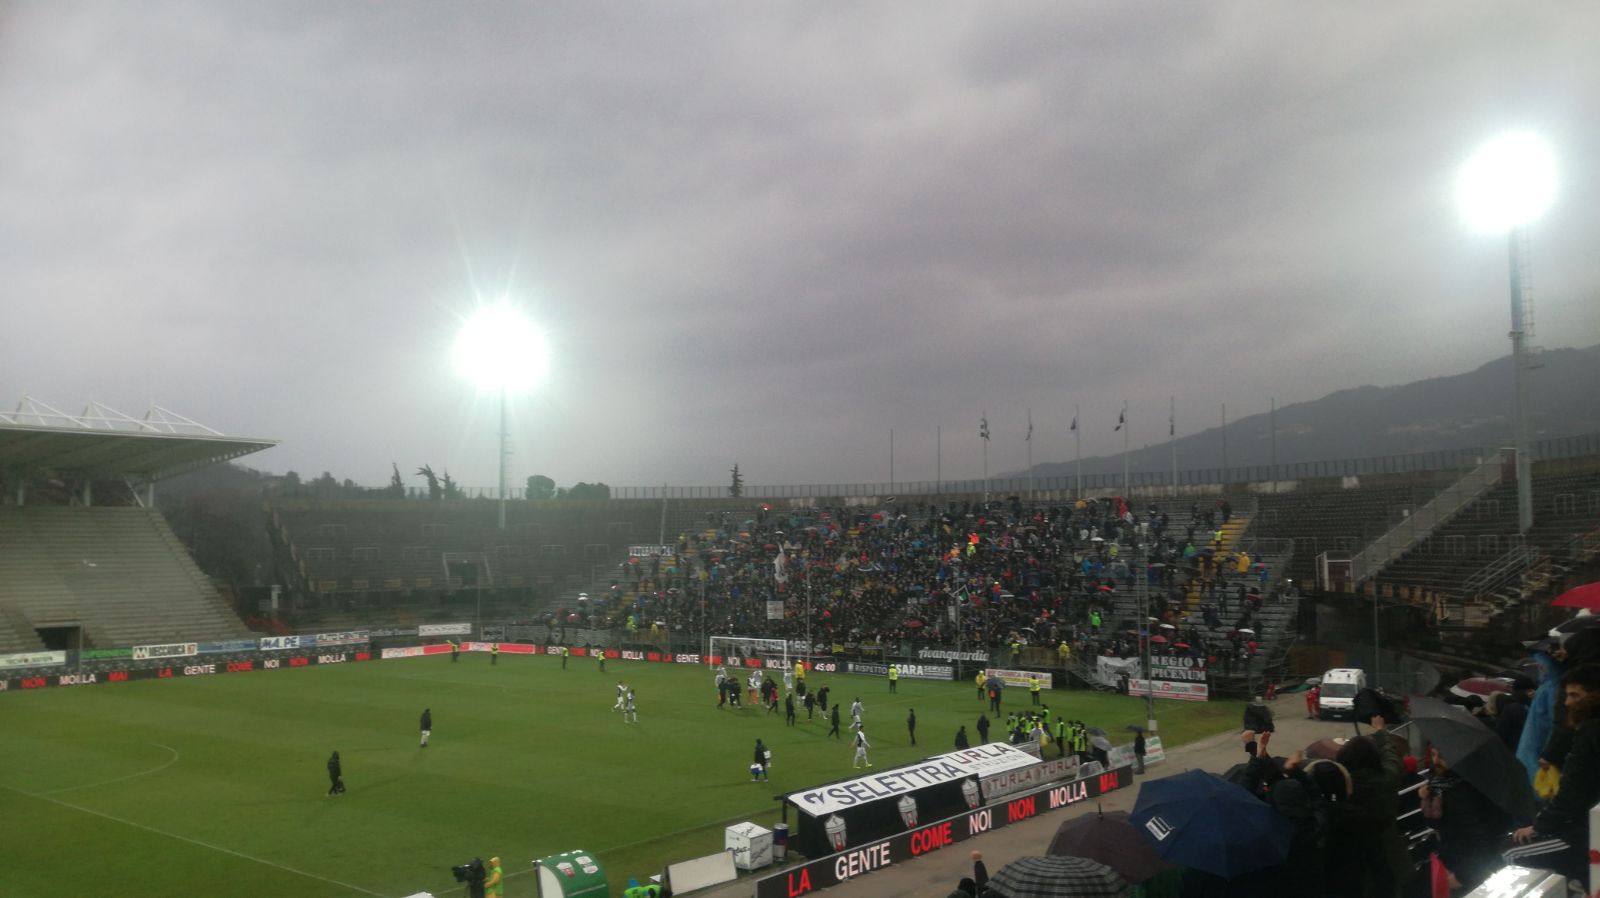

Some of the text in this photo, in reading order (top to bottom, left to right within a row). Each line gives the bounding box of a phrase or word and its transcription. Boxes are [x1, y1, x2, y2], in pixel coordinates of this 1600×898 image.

[60, 673, 97, 686] MOLLA
[184, 664, 216, 676] GENTE
[264, 659, 280, 669] NOI
[318, 653, 347, 664] MOLLA
[676, 654, 700, 663] GENTE
[814, 663, 836, 672] 45:00
[895, 664, 925, 676] SARA
[1151, 655, 1193, 667] REGIO
[1151, 667, 1206, 680] PICENUM
[951, 744, 1017, 765] URLA
[992, 756, 1078, 788] TURLA TURLA
[827, 760, 968, 806] SELETTRA
[788, 771, 1119, 898] LA GENTE COME NOI NON MOLLA MAI
